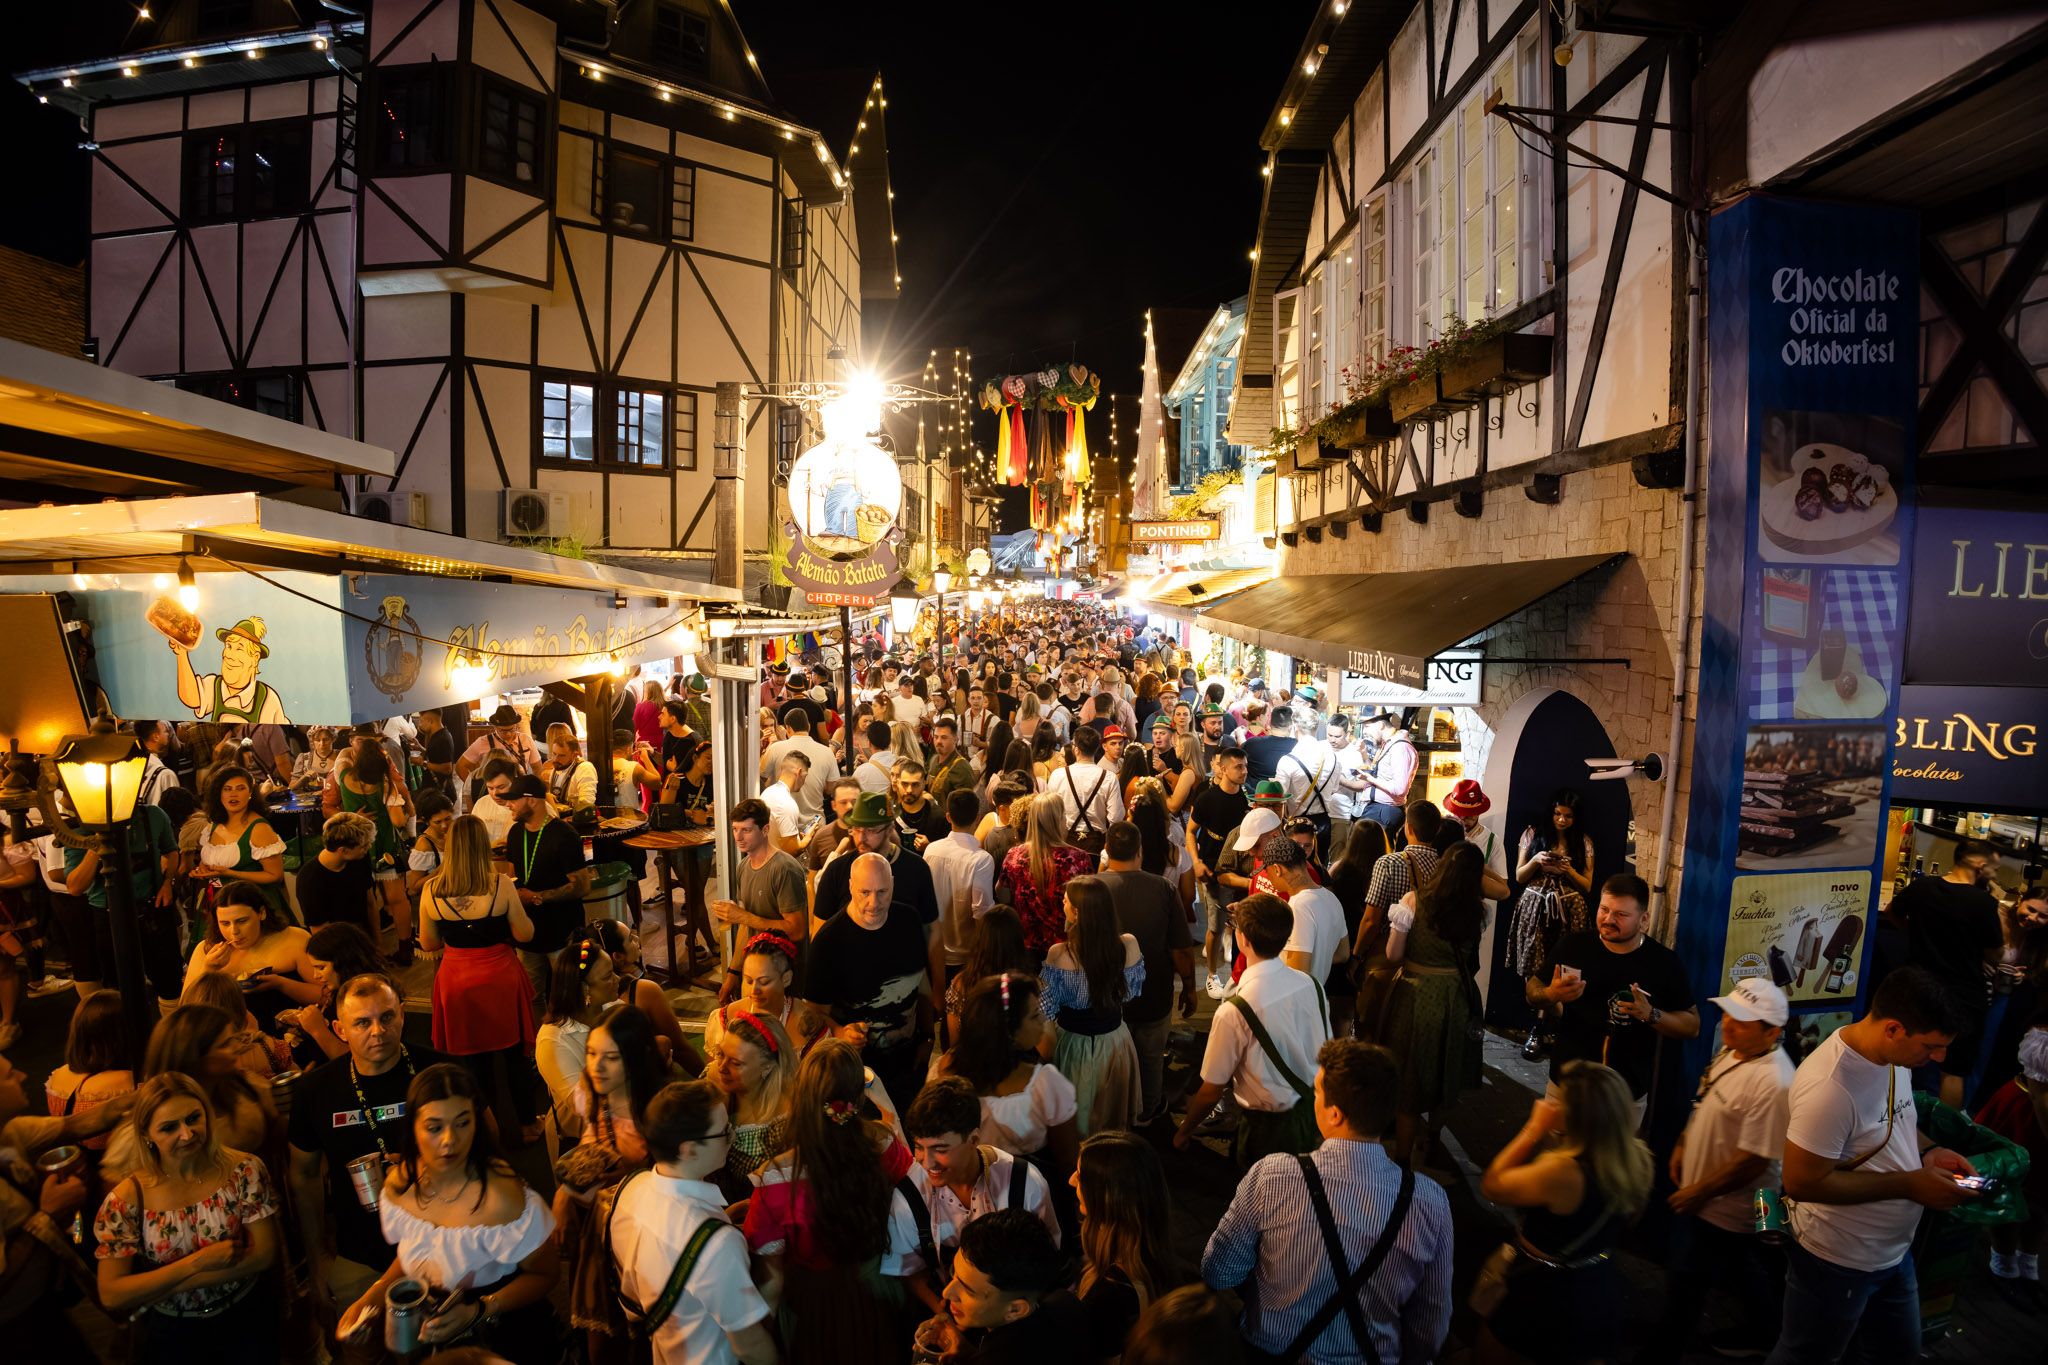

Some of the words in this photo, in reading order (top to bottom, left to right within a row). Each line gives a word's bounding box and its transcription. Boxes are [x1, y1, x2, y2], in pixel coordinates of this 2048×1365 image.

[1771, 267, 1900, 306] Chocolate
[1789, 307, 1856, 334] Oficial
[1864, 307, 1888, 333] da
[1781, 338, 1895, 366] Oktoberfest
[1139, 525, 1212, 537] PONTINHO
[795, 551, 840, 586] Alemão
[843, 559, 888, 586] Batata
[1948, 540, 2048, 599] LIE
[807, 593, 875, 605] CHOPERIA
[1348, 650, 1395, 681] LIEBLING
[1894, 712, 2037, 760] BLING
[1892, 759, 1965, 781] ocolates
[1831, 883, 1859, 892] novo
